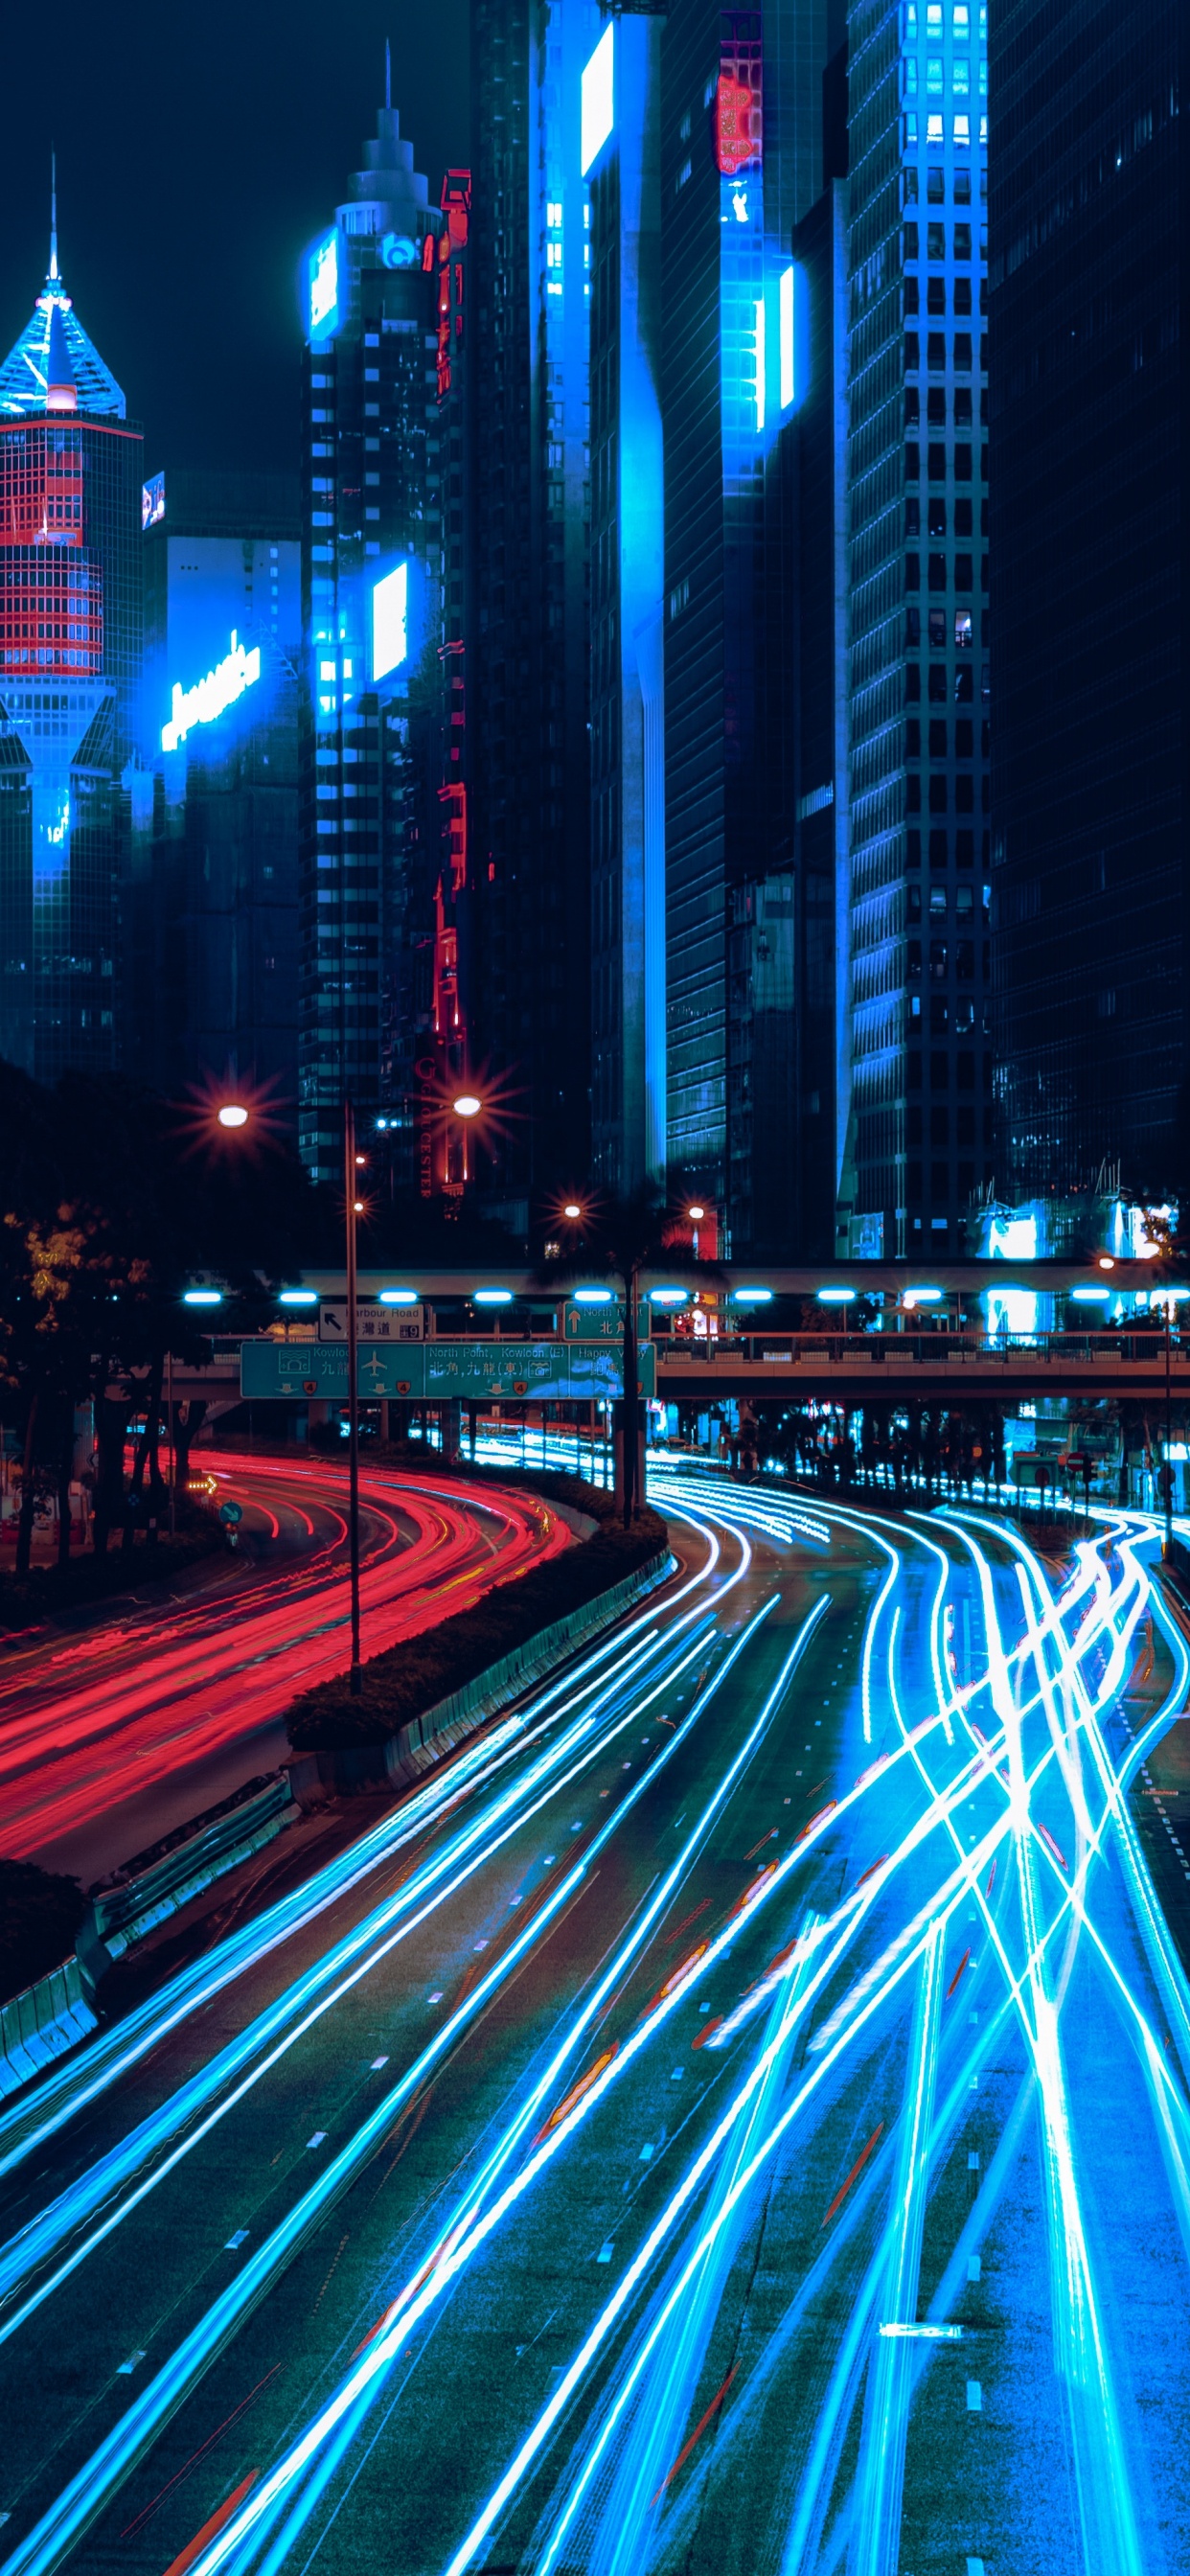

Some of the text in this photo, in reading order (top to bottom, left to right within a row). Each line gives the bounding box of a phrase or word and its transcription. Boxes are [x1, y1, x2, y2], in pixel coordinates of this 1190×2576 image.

[420, 1083, 432, 1199] GLOUCESTER
[392, 1308, 420, 1318] Road
[584, 1306, 612, 1317] North
[409, 1326, 419, 1337] 9
[429, 1346, 564, 1359] North Point, Kowloon (E)
[579, 1347, 610, 1359] Happy
[590, 1362, 625, 1376] 跑馬
